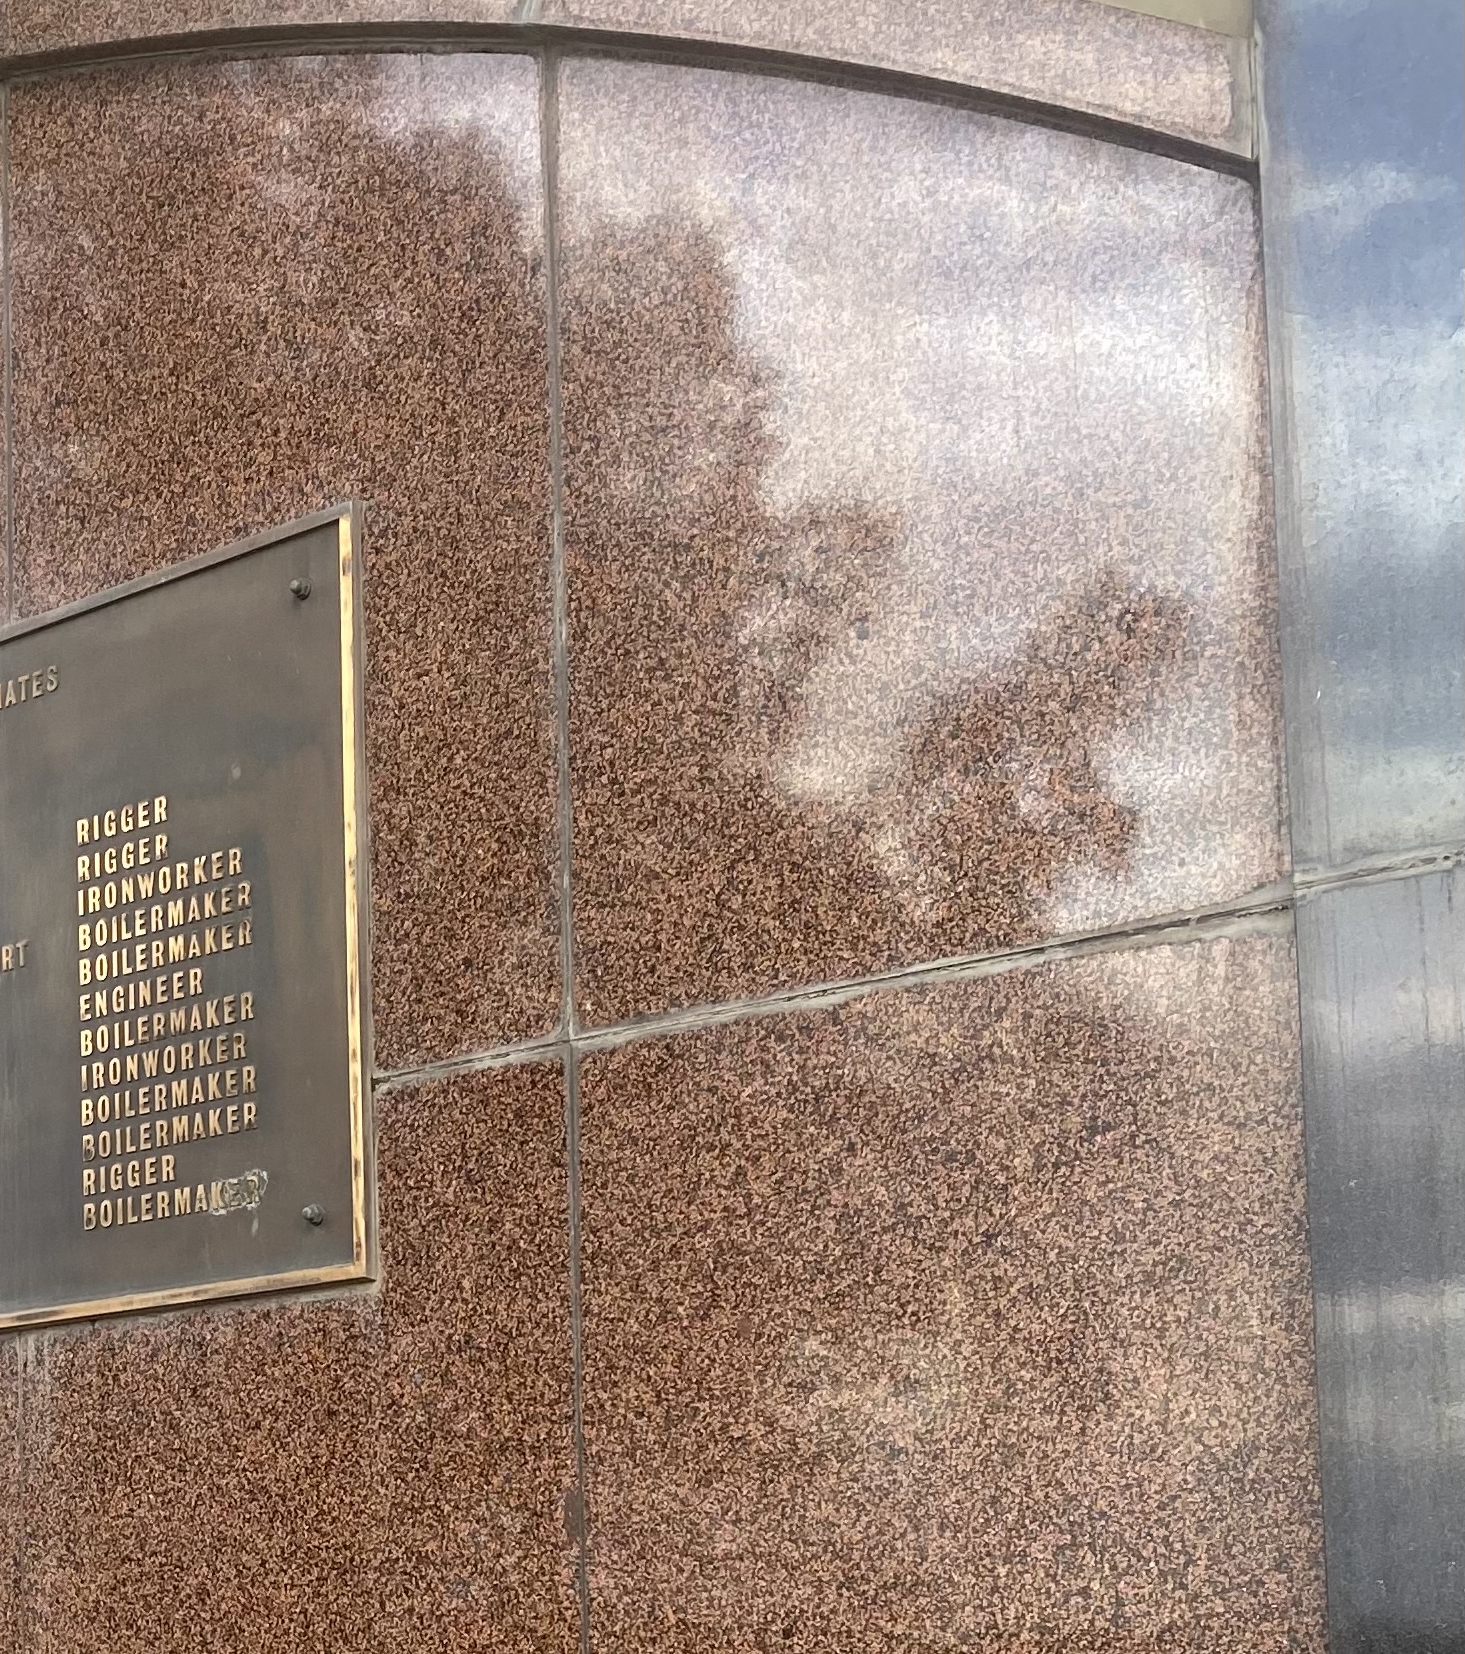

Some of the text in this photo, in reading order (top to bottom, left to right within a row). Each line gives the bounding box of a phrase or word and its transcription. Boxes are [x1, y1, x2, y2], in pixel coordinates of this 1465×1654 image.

[77, 795, 167, 846] RIGGER
[78, 833, 168, 883] RIGGER
[78, 847, 242, 916] IRONWORKER
[79, 881, 251, 951] BOILERMAKER
[79, 917, 253, 986] BOILERMAKER
[80, 967, 203, 1022] ENGINEER
[80, 991, 254, 1057] BOILERMAKER
[81, 1033, 246, 1092] IRONWORKER
[81, 1065, 256, 1127] BOILERMAKER
[83, 1102, 258, 1162] BOILERMAKER
[83, 1154, 175, 1196] RIGGER
